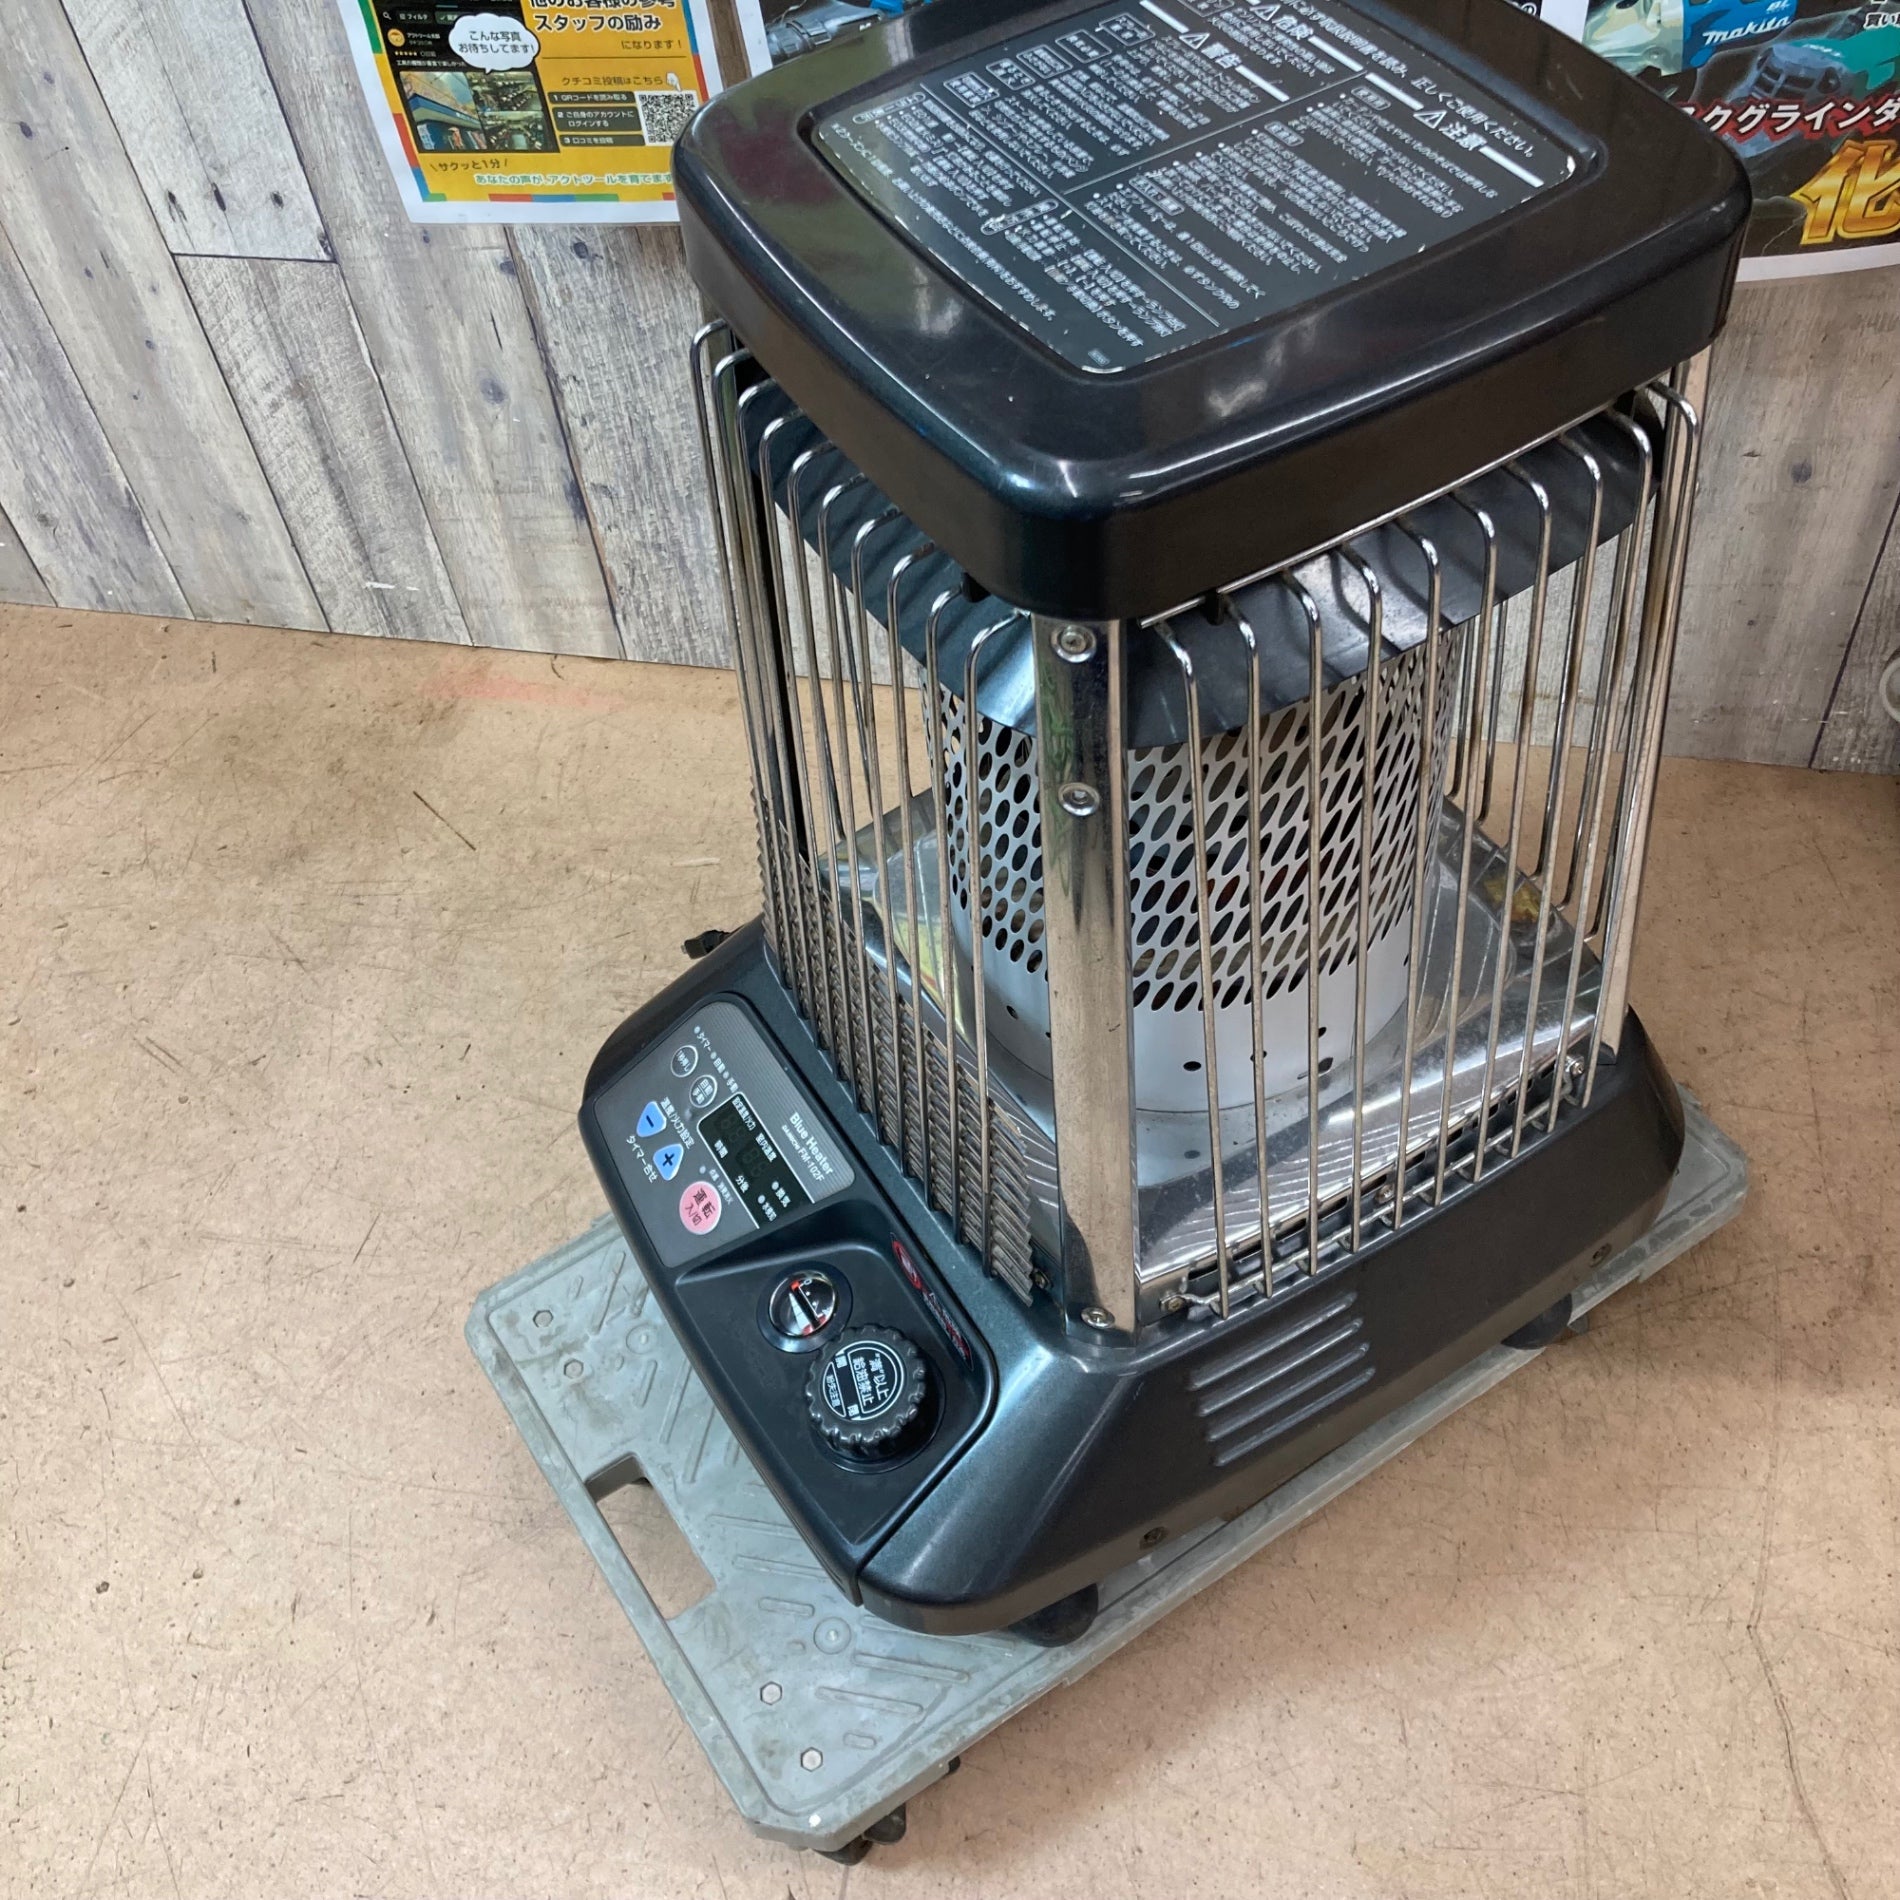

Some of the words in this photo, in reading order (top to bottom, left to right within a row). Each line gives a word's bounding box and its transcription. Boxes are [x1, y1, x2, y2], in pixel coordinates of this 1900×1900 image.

[469, 31, 521, 42] こんな写真
[534, 14, 662, 31] スタッフの励み
[1272, 15, 1314, 40] 危険
[1702, 16, 1791, 46] makita
[1197, 41, 1247, 70] 警告
[561, 76, 664, 87] クチコミ投稿はこちら
[1435, 121, 1489, 151] 注意
[713, 1057, 726, 1074] 自動
[692, 1087, 705, 1105] 手動
[700, 1078, 713, 1096] 自動
[660, 1096, 695, 1149] 温度/火力設定
[789, 1111, 809, 1140] Blue
[806, 1136, 834, 1175] Heater
[626, 1135, 658, 1183] タイマー合せ
[798, 1147, 825, 1182] FM-102F
[685, 1203, 703, 1227] 入/切
[692, 1188, 716, 1220] 運転
[826, 1375, 841, 1408] 紛失注意
[853, 1356, 875, 1407] 給油禁止
